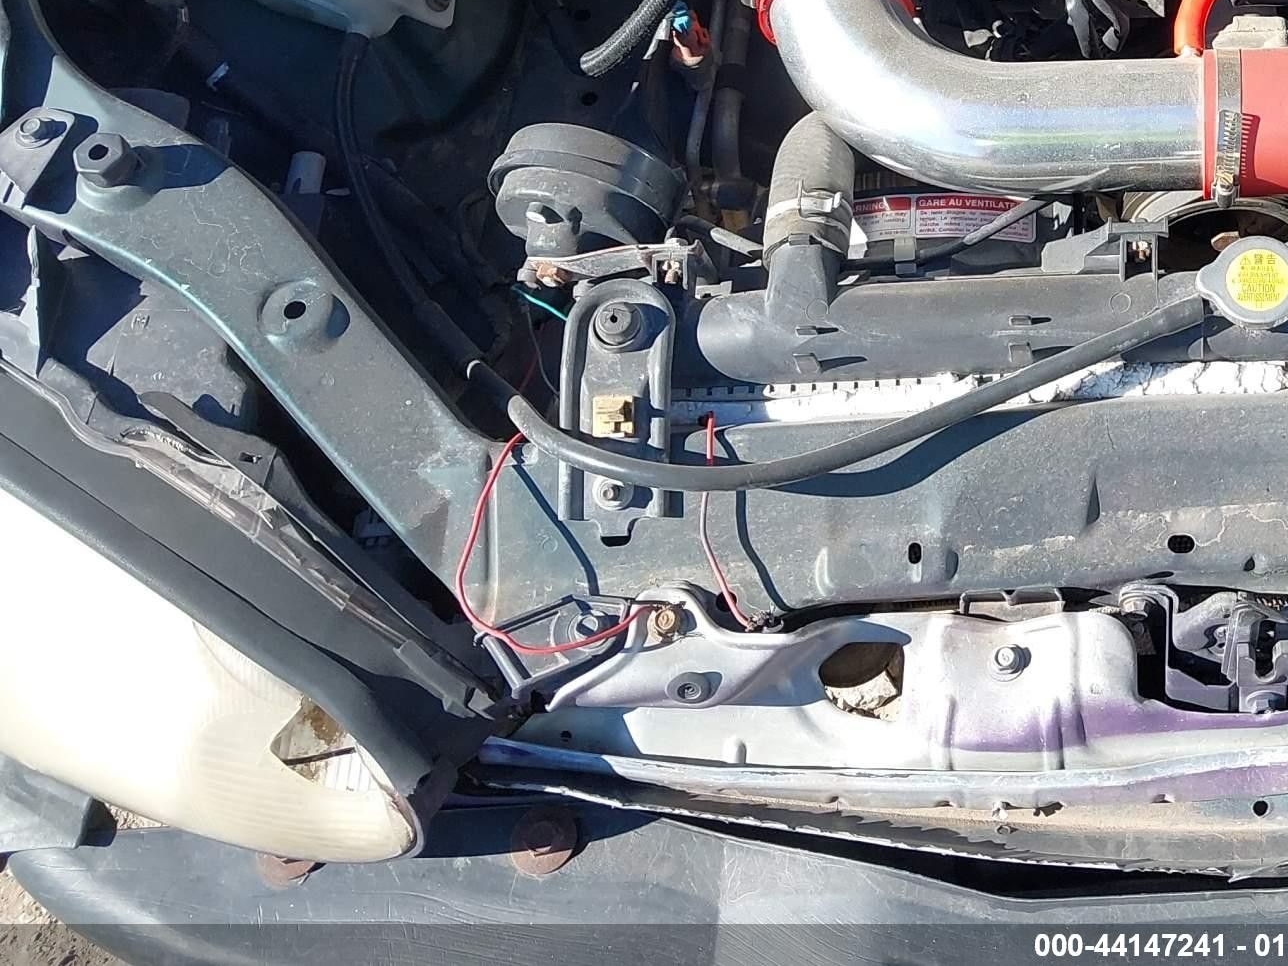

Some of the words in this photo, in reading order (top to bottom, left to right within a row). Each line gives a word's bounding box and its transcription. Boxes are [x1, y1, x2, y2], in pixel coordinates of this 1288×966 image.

[919, 199, 945, 207] GARE
[948, 198, 963, 206] AU
[1241, 283, 1275, 293] CAUTION
